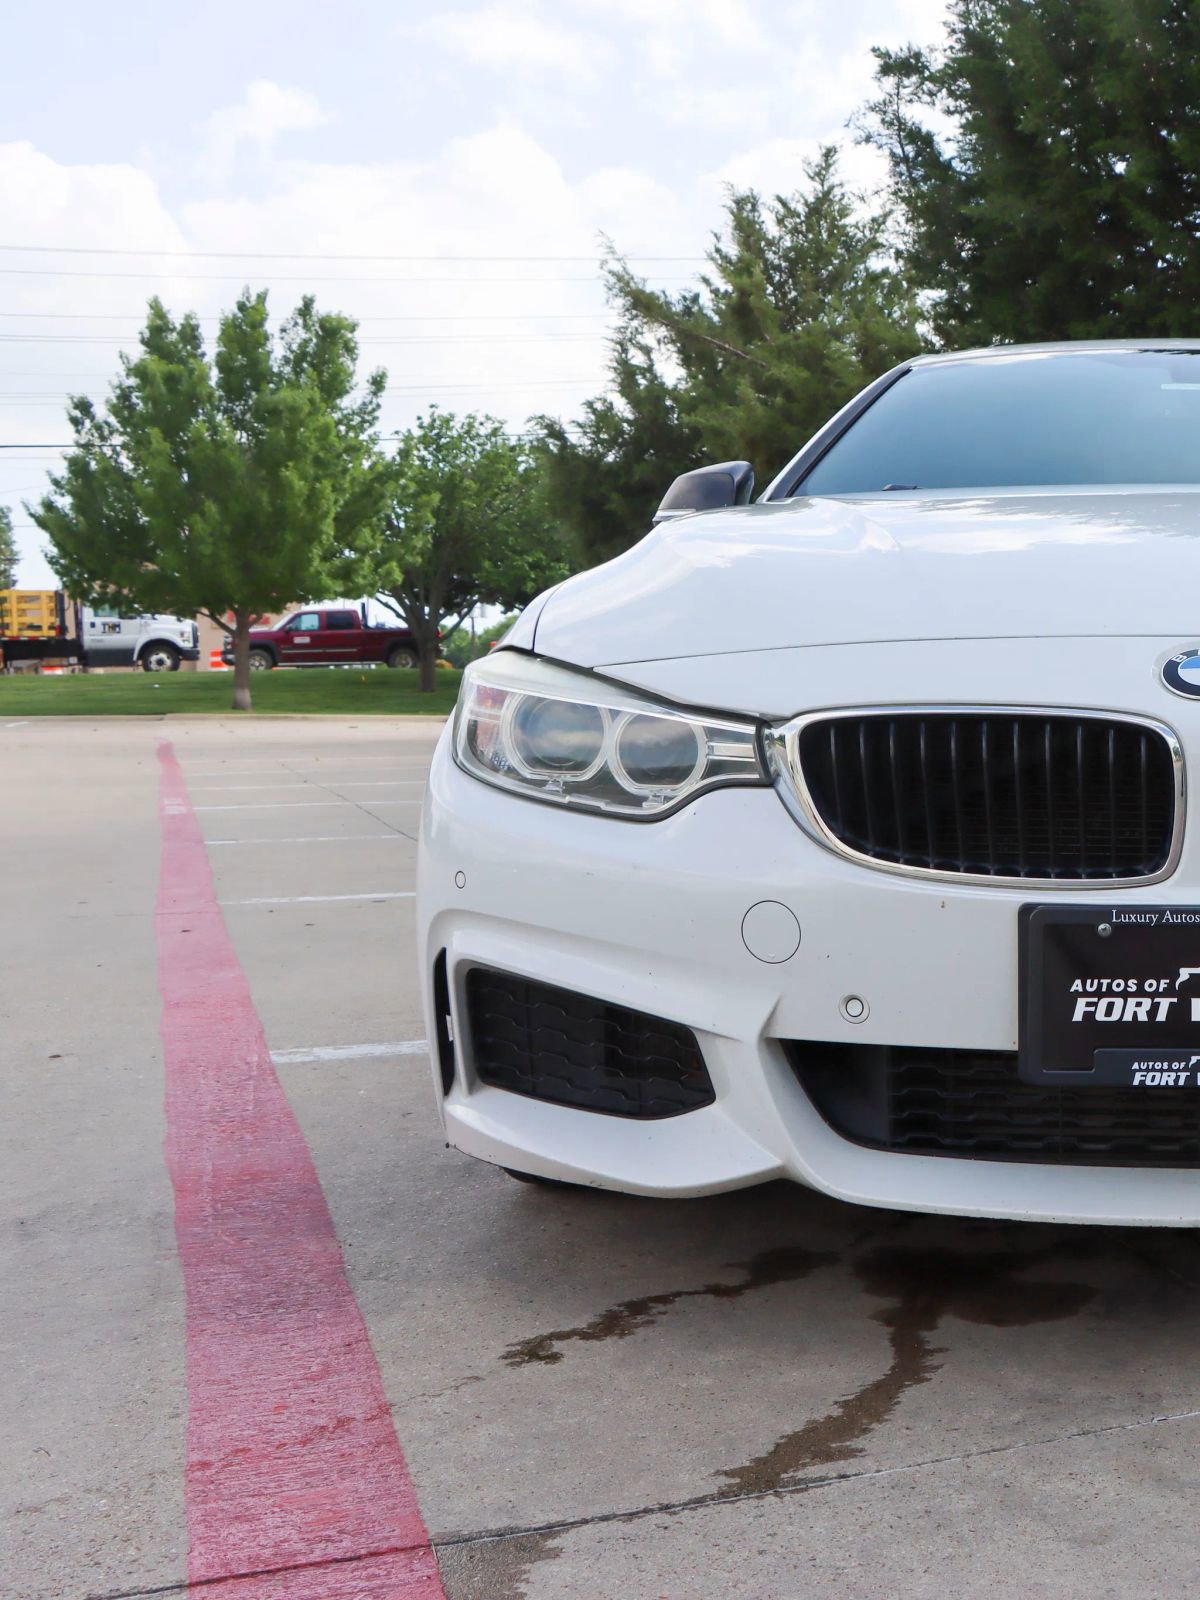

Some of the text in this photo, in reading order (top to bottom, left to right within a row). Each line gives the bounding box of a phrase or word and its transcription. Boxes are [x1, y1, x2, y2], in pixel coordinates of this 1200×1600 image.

[1111, 909, 1158, 926] Luxury
[1162, 910, 1200, 924] Autos
[1070, 979, 1170, 993] AUTOS OF
[1072, 997, 1178, 1022] FORT
[1131, 1061, 1187, 1070] AUTOS OF
[1132, 1072, 1191, 1086] FORT
